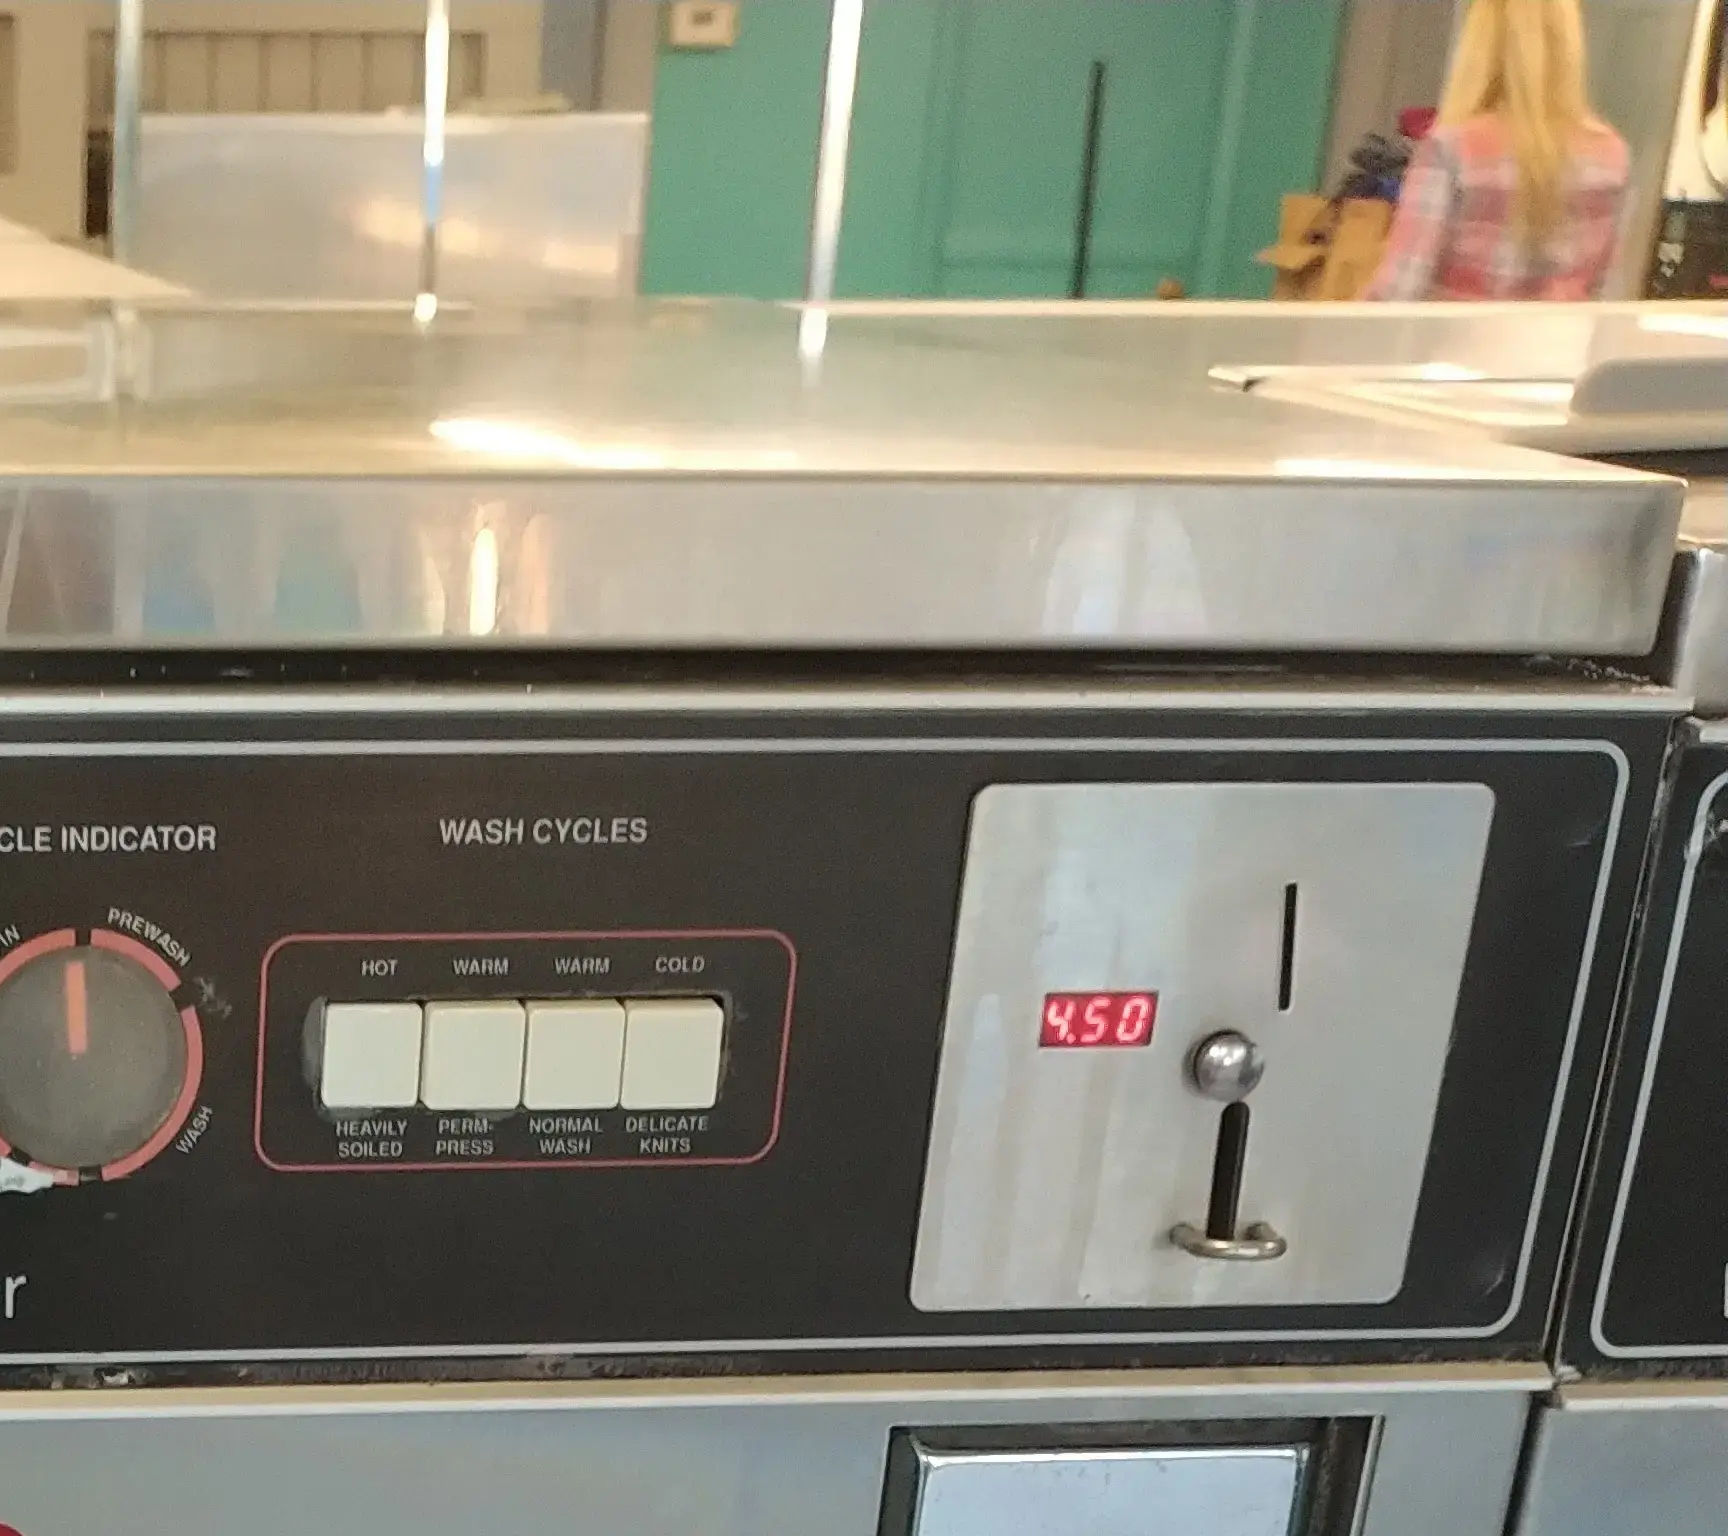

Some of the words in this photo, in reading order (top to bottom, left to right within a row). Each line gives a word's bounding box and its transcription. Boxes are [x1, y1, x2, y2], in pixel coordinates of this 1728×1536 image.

[61, 825, 217, 853] INDICATOR
[439, 818, 524, 846] WASH
[532, 817, 648, 845] CYCLES
[107, 907, 193, 968] PREWASH
[361, 959, 398, 977] HOT
[453, 957, 509, 976] WARM
[554, 956, 610, 975] WARM
[654, 956, 706, 974] COLD
[175, 1105, 214, 1155] WASH
[335, 1119, 407, 1139] HEAVILY
[528, 1116, 604, 1135] NORMAL
[625, 1115, 709, 1134] DELICATE
[338, 1139, 404, 1158] SOILED
[435, 1138, 494, 1157] PRESS
[539, 1137, 592, 1156] WASH
[639, 1135, 691, 1154] KNITS
